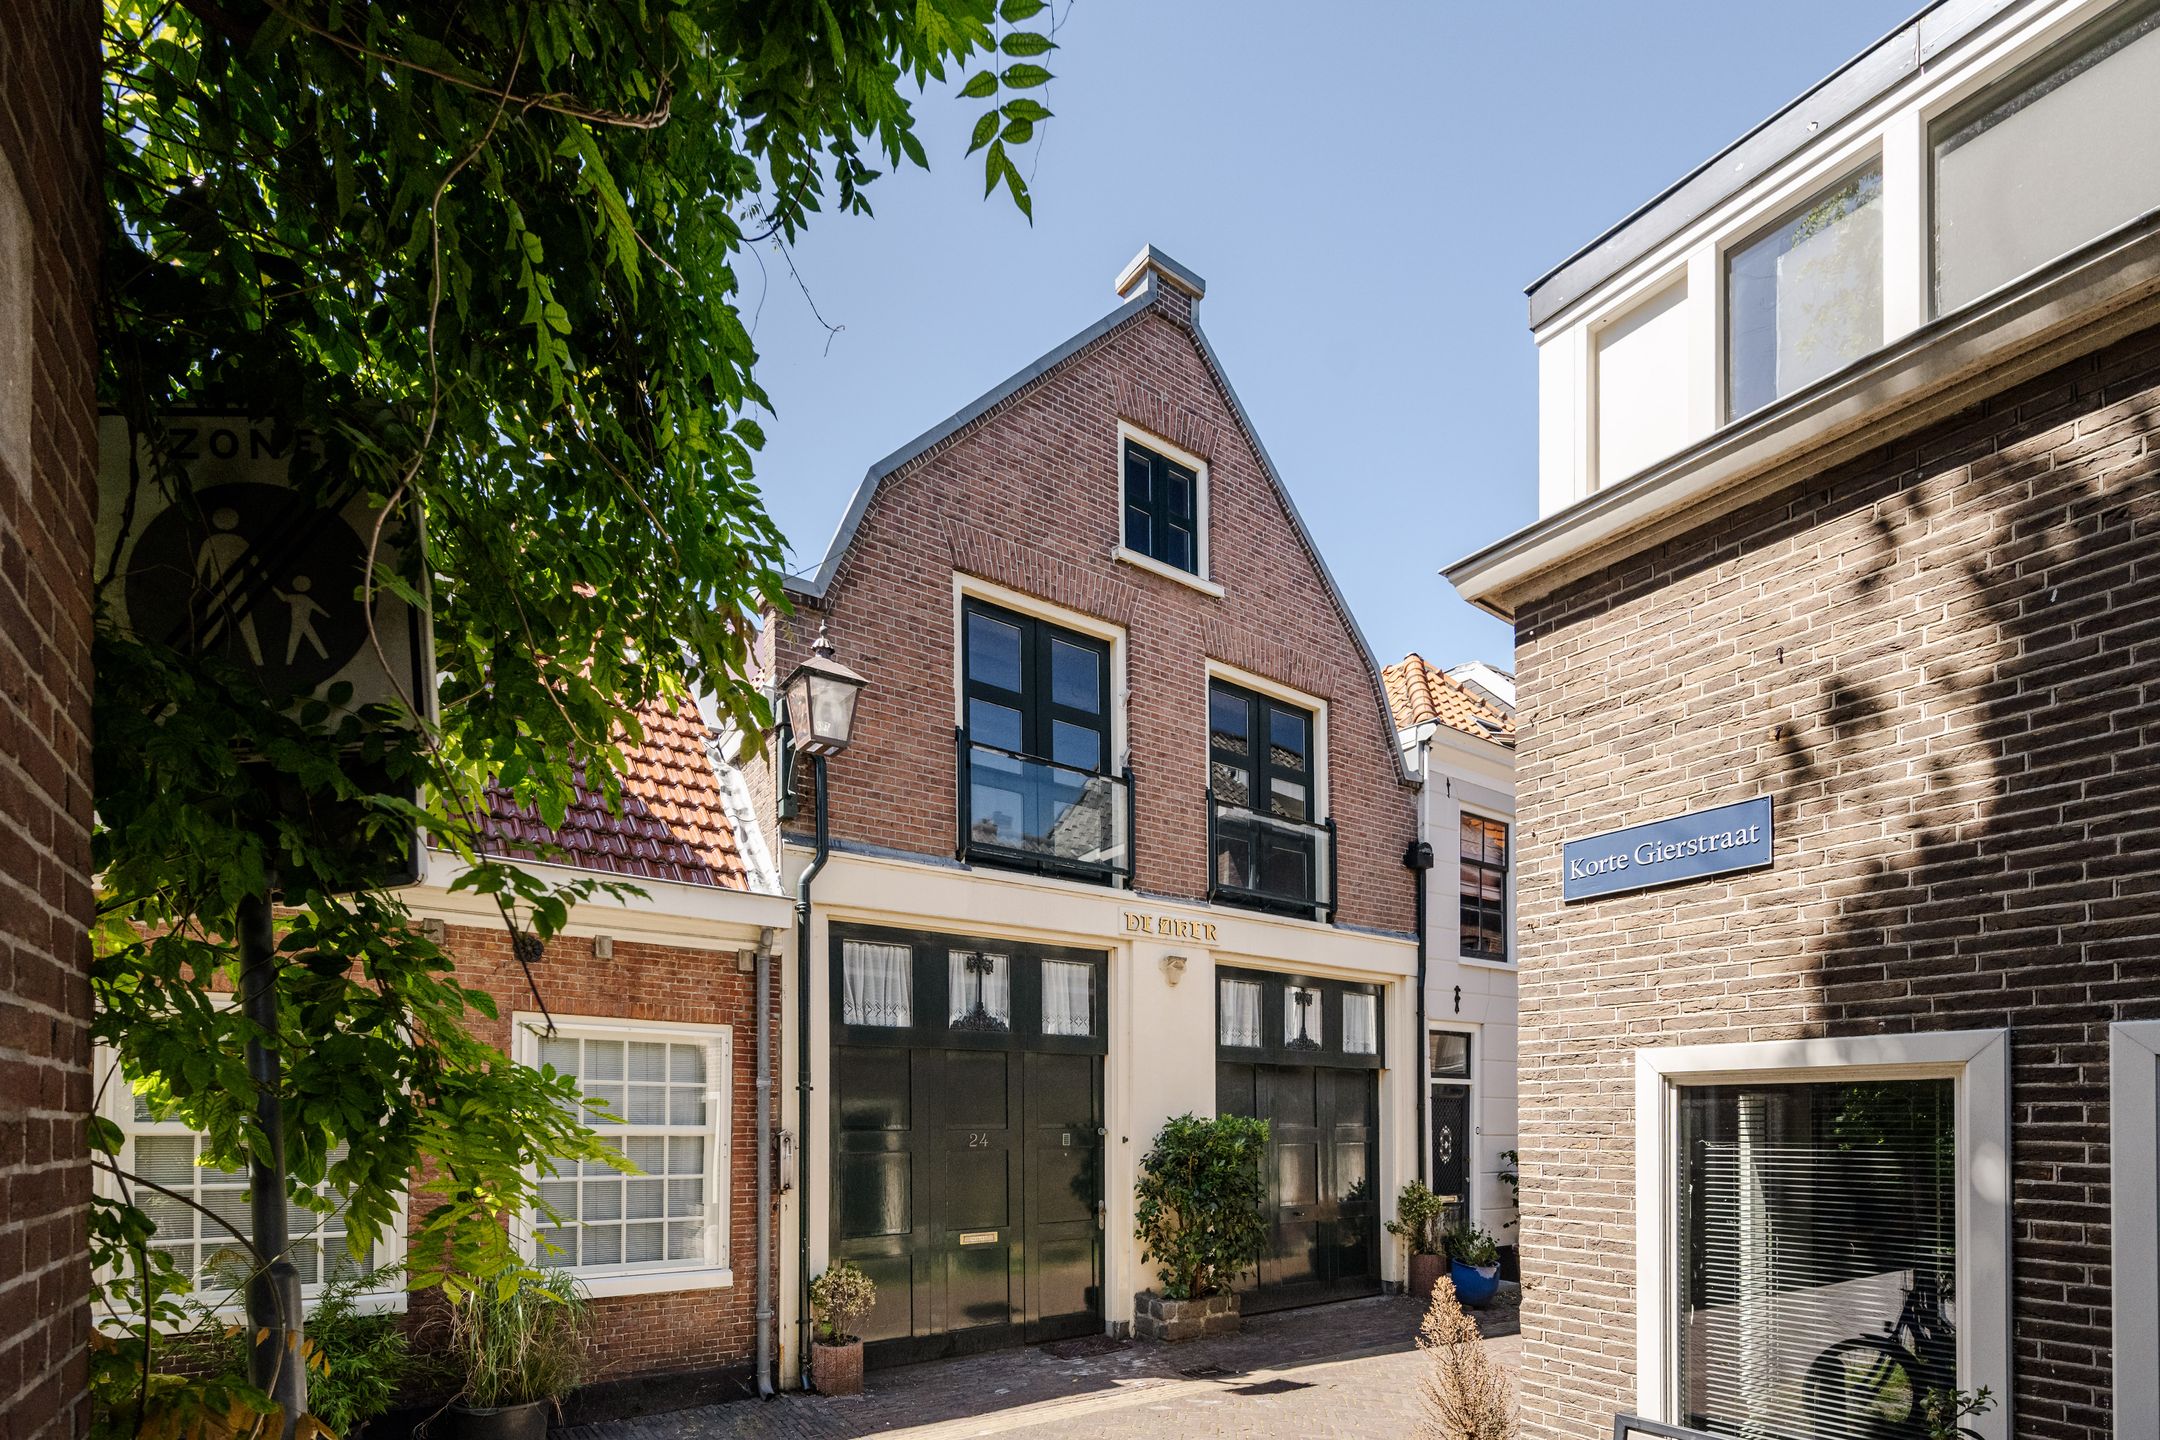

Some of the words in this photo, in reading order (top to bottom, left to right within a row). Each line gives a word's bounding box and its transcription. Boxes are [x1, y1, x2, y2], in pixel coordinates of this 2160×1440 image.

[168, 427, 321, 460] ZONE
[1569, 853, 1629, 881] Korte
[1633, 824, 1760, 866] Gierstraat
[1123, 911, 1153, 934] DE
[969, 1132, 989, 1147] 24
